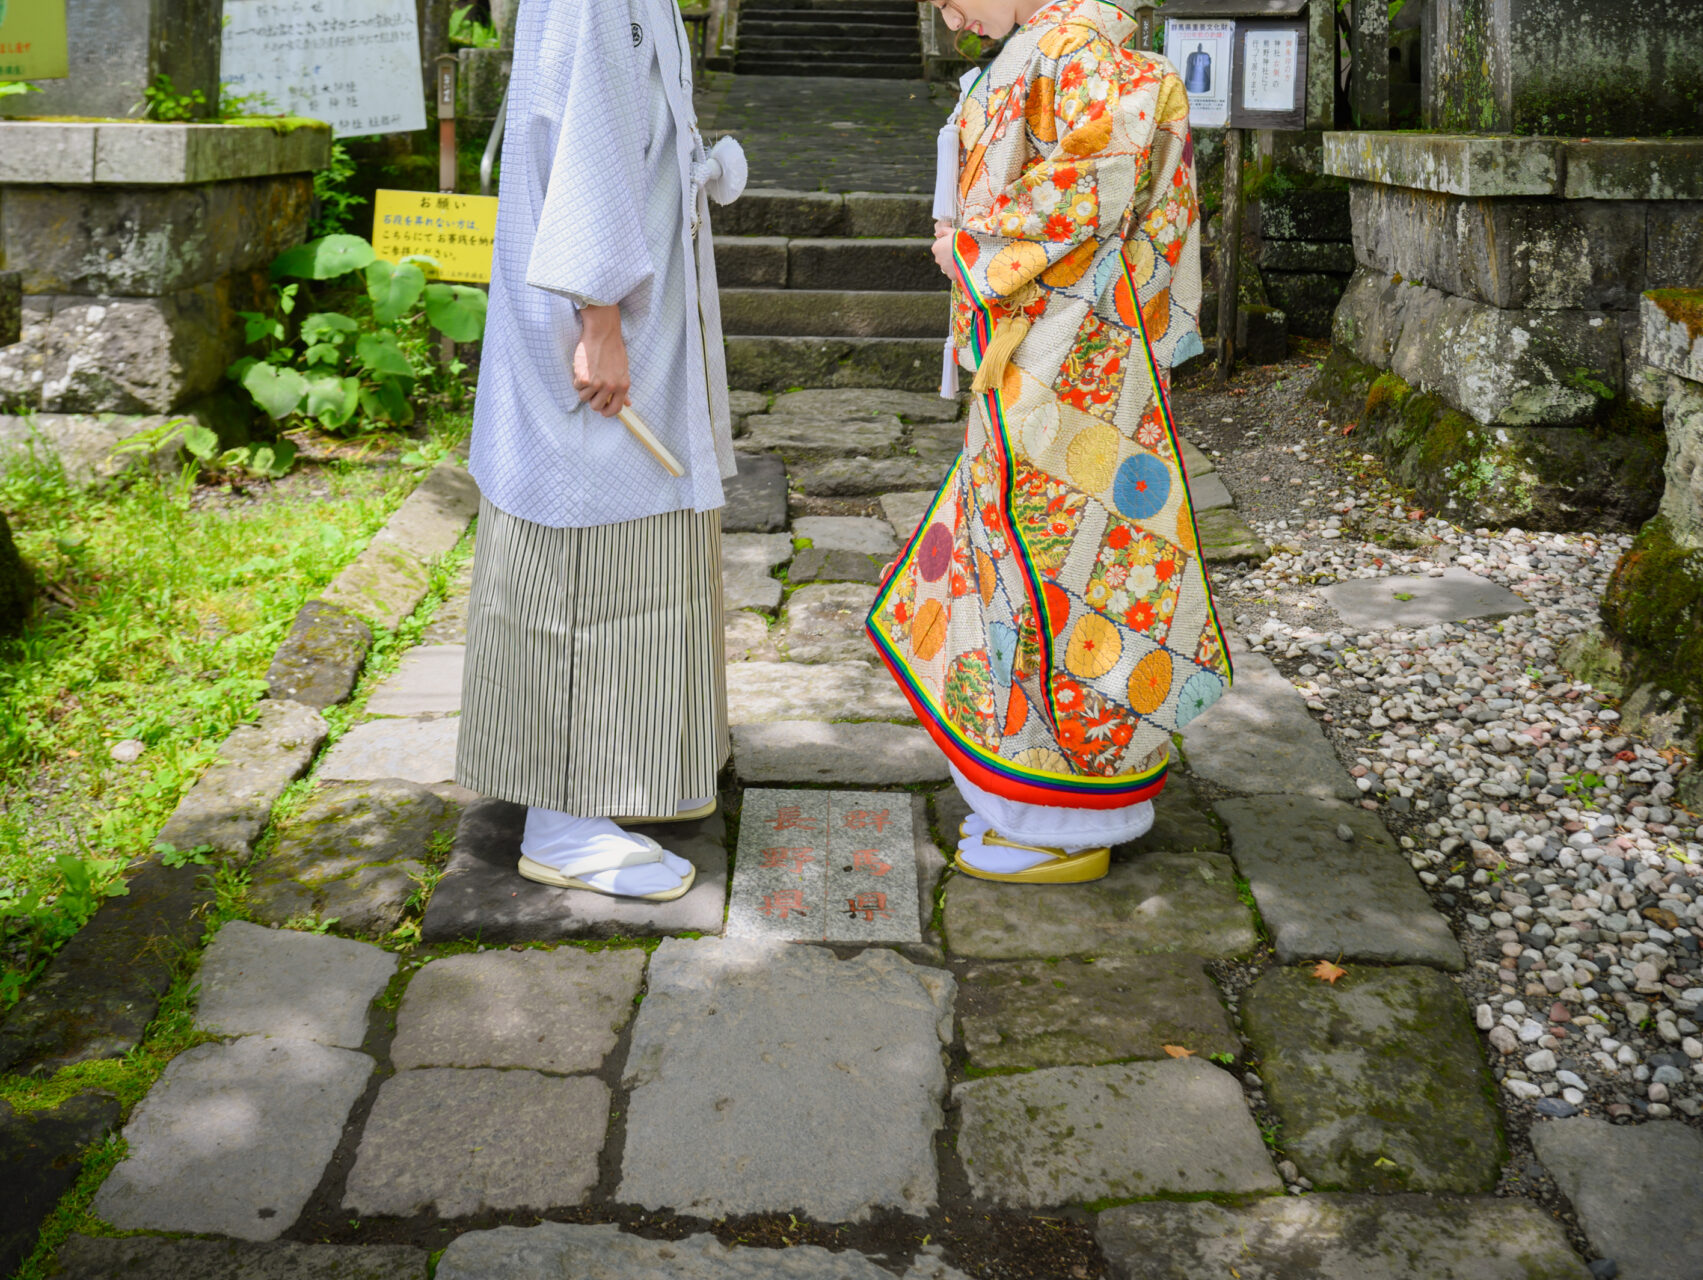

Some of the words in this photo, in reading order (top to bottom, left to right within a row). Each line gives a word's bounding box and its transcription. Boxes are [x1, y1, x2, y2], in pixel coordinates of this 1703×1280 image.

[1171, 23, 1228, 32] 群馬県重要文化財
[420, 196, 466, 210] お願い
[757, 805, 817, 919] 長野県
[840, 808, 897, 923] 群馬県
